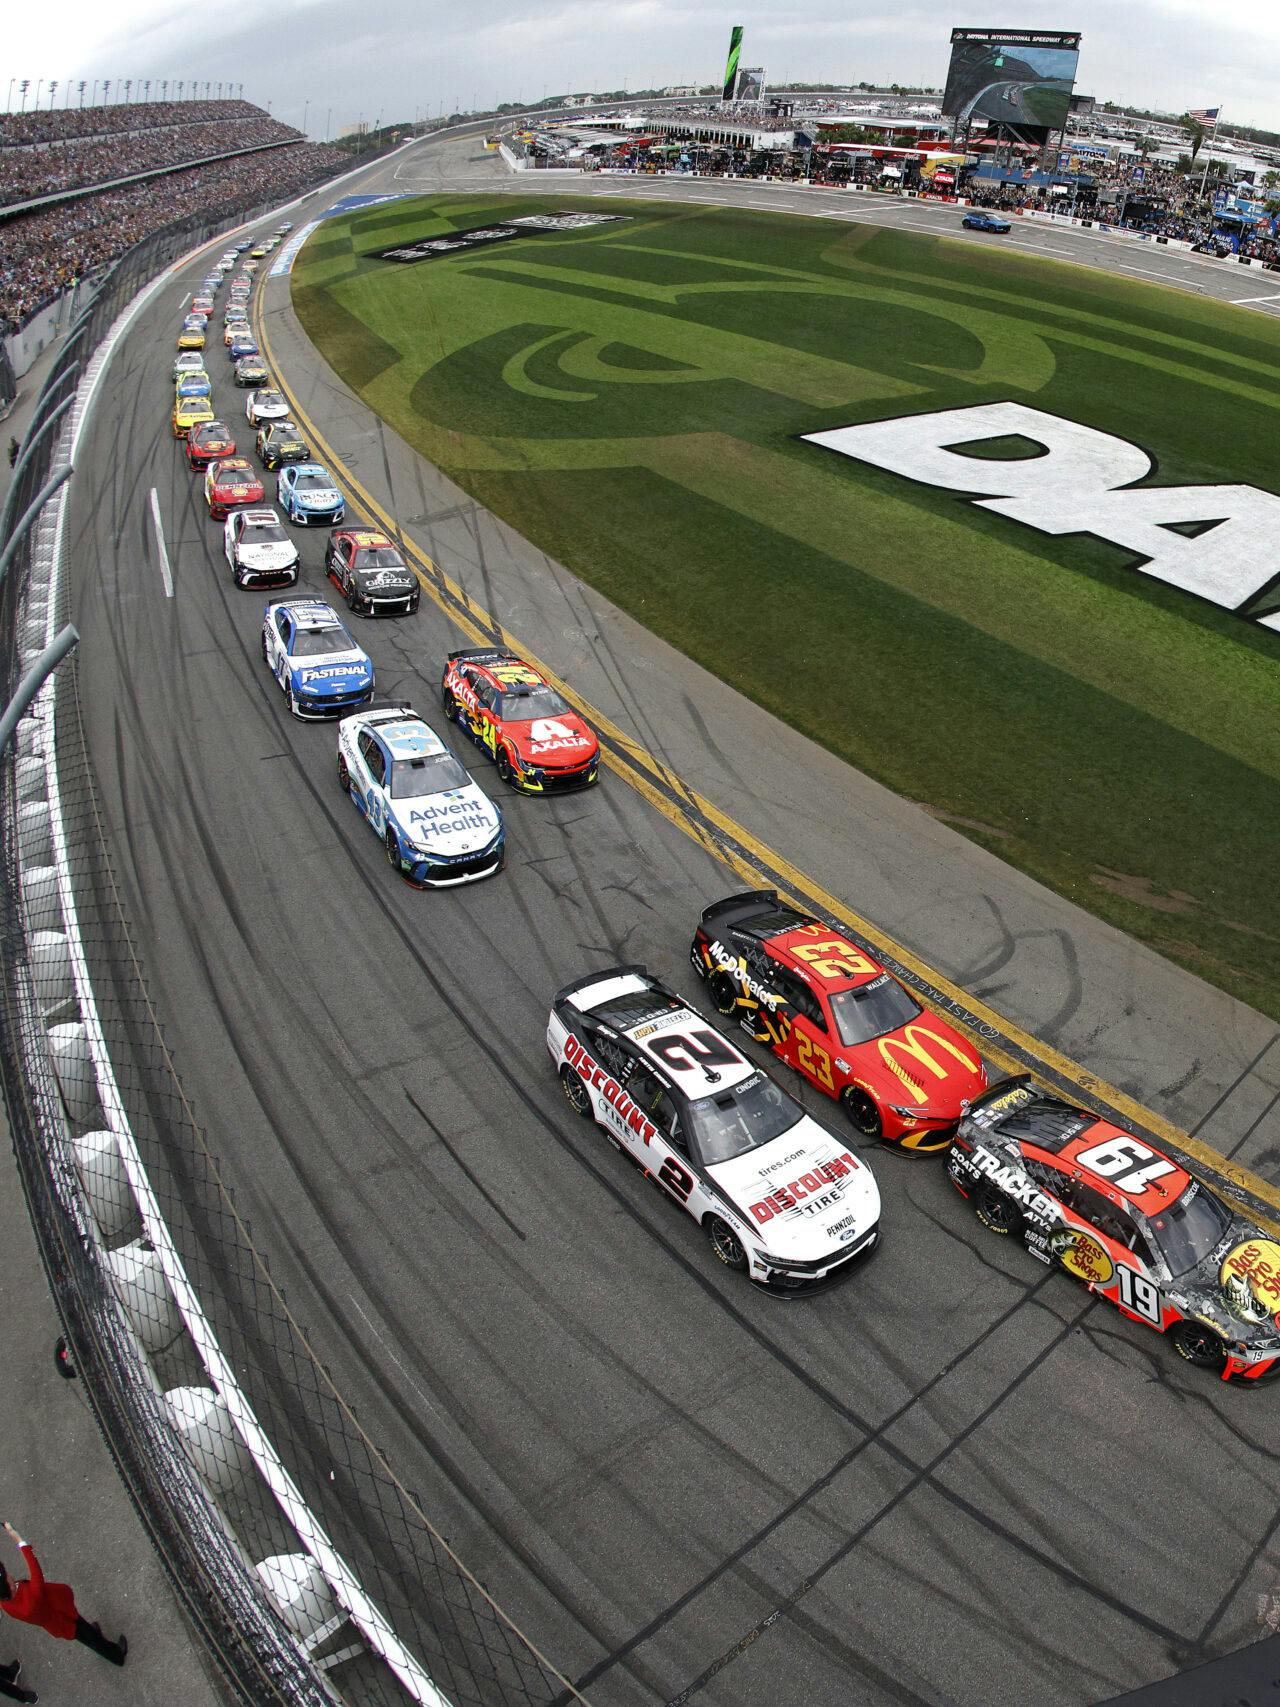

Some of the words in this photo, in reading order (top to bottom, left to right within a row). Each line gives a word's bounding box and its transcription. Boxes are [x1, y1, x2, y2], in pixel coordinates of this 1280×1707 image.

[990, 34, 1031, 42] INTERNATIONAL
[302, 665, 368, 684] FASTENAL
[446, 673, 479, 713] AXALTA
[482, 715, 498, 760] 24
[531, 737, 591, 755] AXALTA
[409, 799, 483, 824] Advent
[420, 816, 493, 840] Health
[449, 852, 484, 865] CAMRY
[789, 941, 877, 979] 23
[875, 951, 920, 985] CHANCES
[708, 940, 777, 1012] McDonald's
[865, 975, 891, 991] WALLACE
[917, 984, 947, 1005] TAKE
[947, 1002, 979, 1027] FAST
[633, 1025, 657, 1040] LIGHT
[979, 1024, 1000, 1039] GO
[647, 1030, 744, 1072] 2
[794, 1027, 835, 1091] 23
[563, 1033, 659, 1147] DISCOUNT
[735, 1077, 762, 1096] CINDRIC
[853, 1077, 881, 1100] GOODYEAR
[991, 1088, 1028, 1109] Cabela's
[602, 1102, 633, 1138] TIRE
[902, 1117, 917, 1127] 23
[757, 1149, 807, 1178] tires.com
[950, 1146, 982, 1179] BOATS
[1075, 1135, 1178, 1196] 19
[657, 1156, 694, 1204] 2
[748, 1152, 860, 1226] DISCOUNT
[969, 1144, 1063, 1224] TRACKER
[804, 1190, 841, 1215] TIRE
[1181, 1182, 1201, 1207] BRISCOE
[714, 1204, 741, 1230] GOODYEAR
[826, 1214, 857, 1238] PENNZOIL
[1074, 1246, 1094, 1265] Pro
[1076, 1235, 1102, 1260] Bass
[1070, 1255, 1103, 1281] Shops
[1227, 1244, 1261, 1279] Bass
[1246, 1260, 1273, 1288] Pro
[1116, 1262, 1160, 1324] 19
[1194, 1312, 1230, 1339] GOODYEAR
[1252, 1350, 1264, 1361] 19
